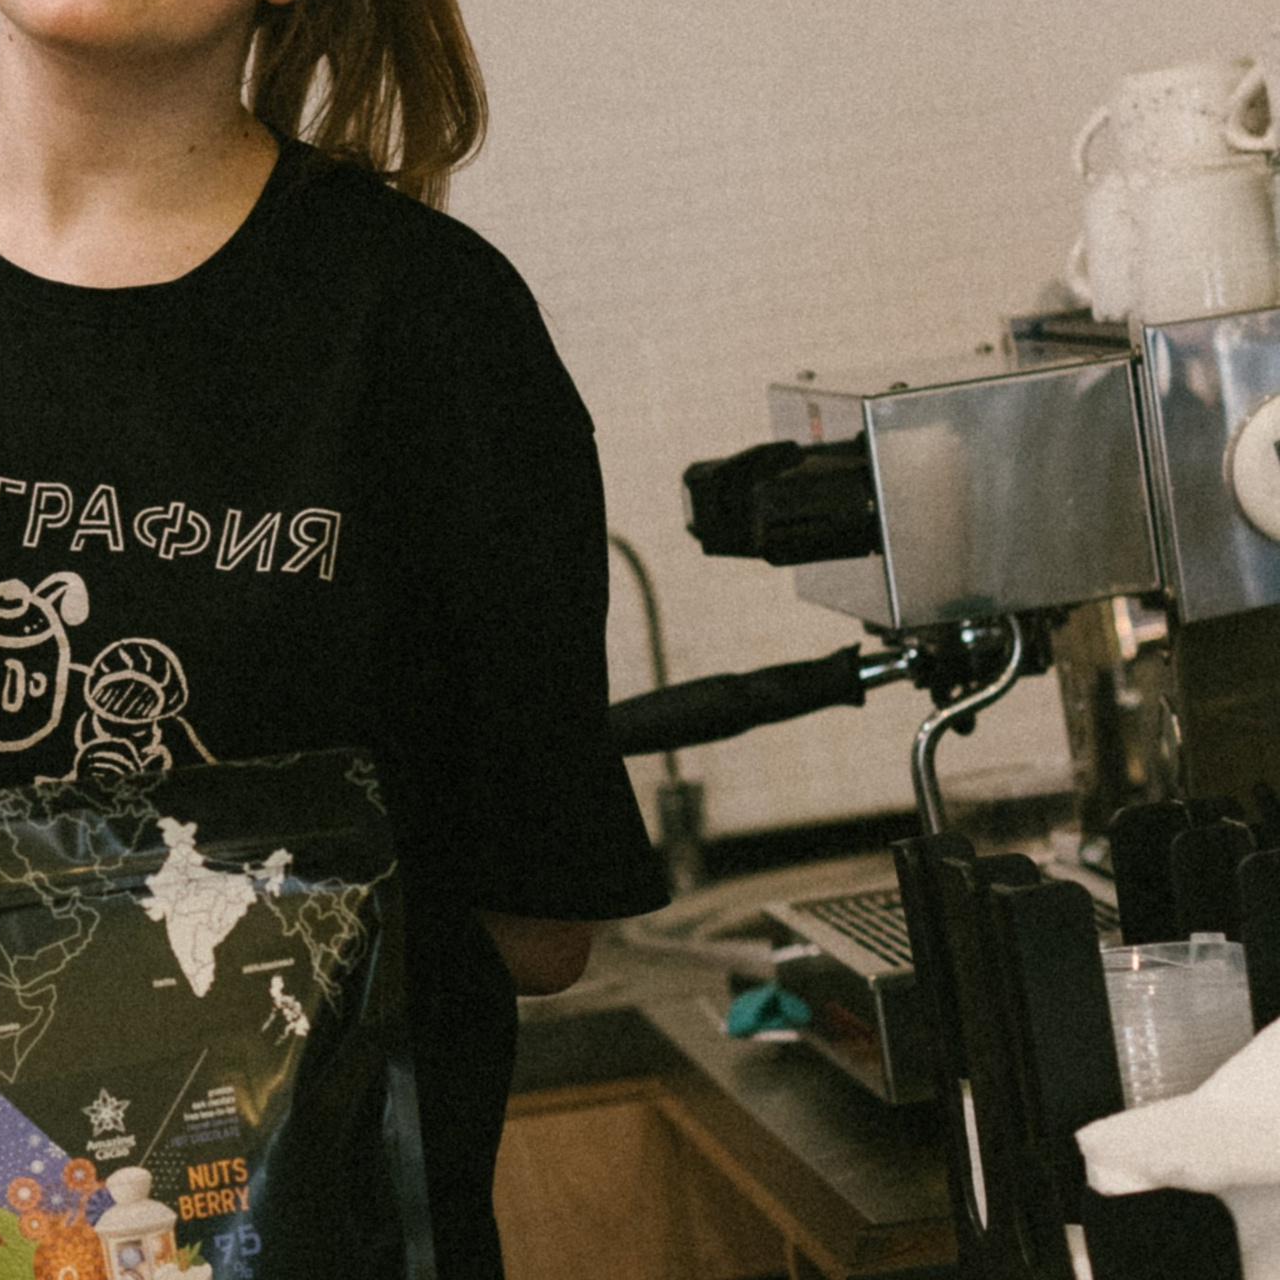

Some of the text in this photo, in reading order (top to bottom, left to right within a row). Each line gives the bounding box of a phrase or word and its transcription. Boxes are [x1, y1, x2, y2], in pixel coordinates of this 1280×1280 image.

[187, 1157, 249, 1191] NUTS
[178, 1186, 251, 1222] BERRY
[213, 1223, 263, 1266] 75
